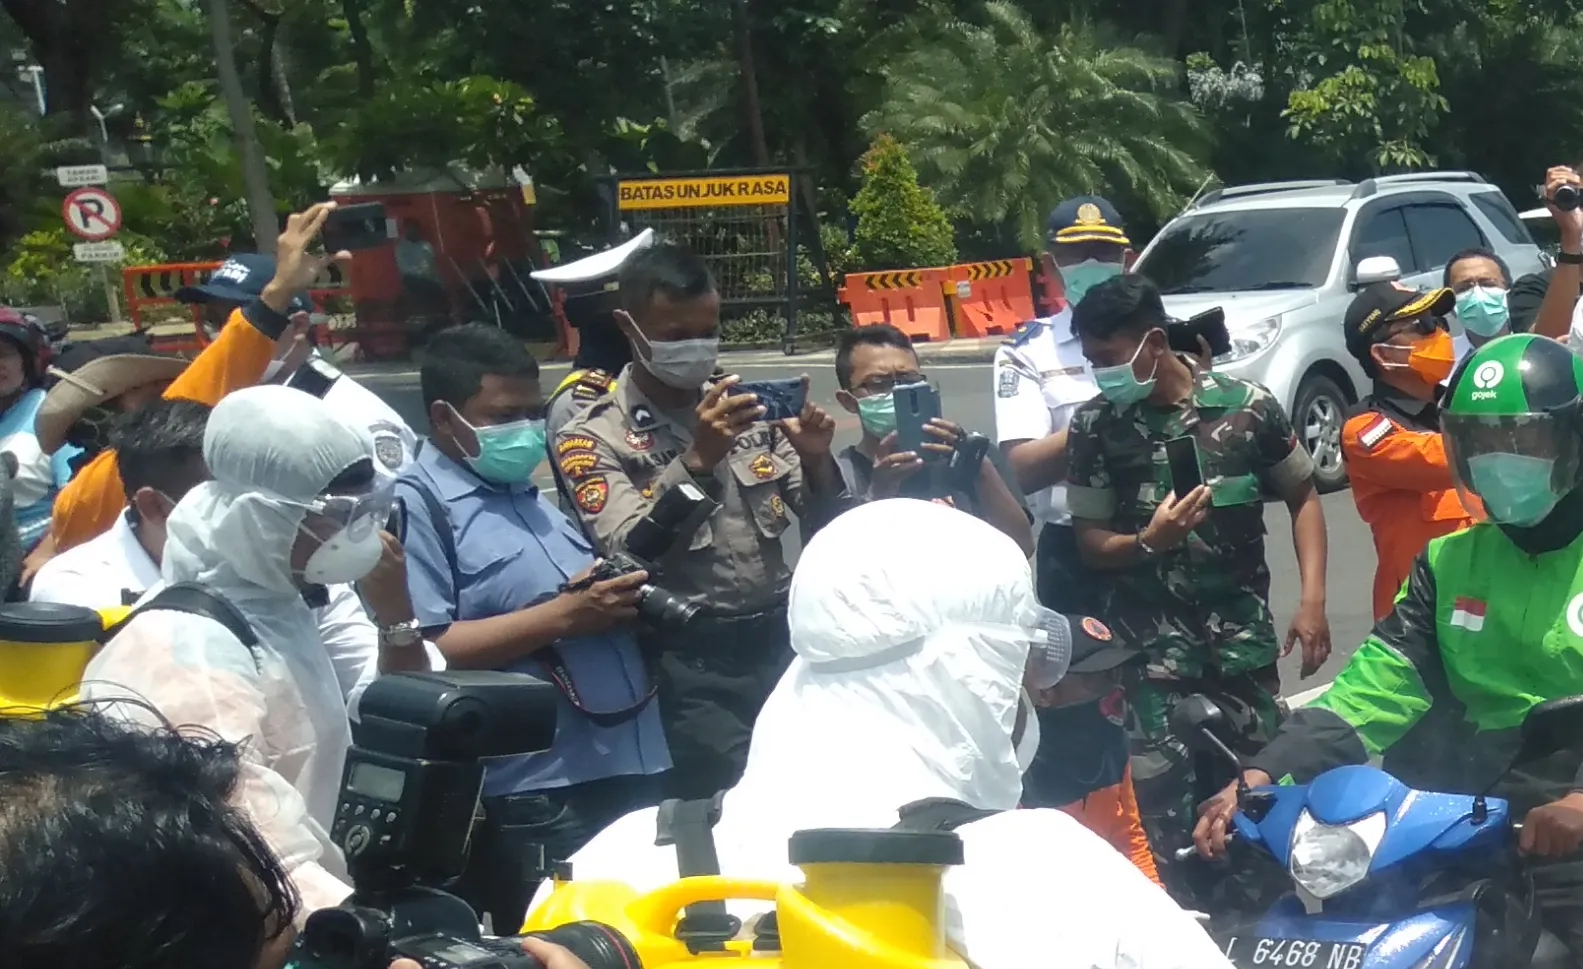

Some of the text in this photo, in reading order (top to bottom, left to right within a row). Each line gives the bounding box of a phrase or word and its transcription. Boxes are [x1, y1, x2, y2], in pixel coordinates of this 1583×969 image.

[620, 181, 787, 200] BATAS UNJUK RASA
[1472, 390, 1497, 401] gojek
[1225, 937, 1238, 963] L
[1252, 938, 1322, 967] 6468
